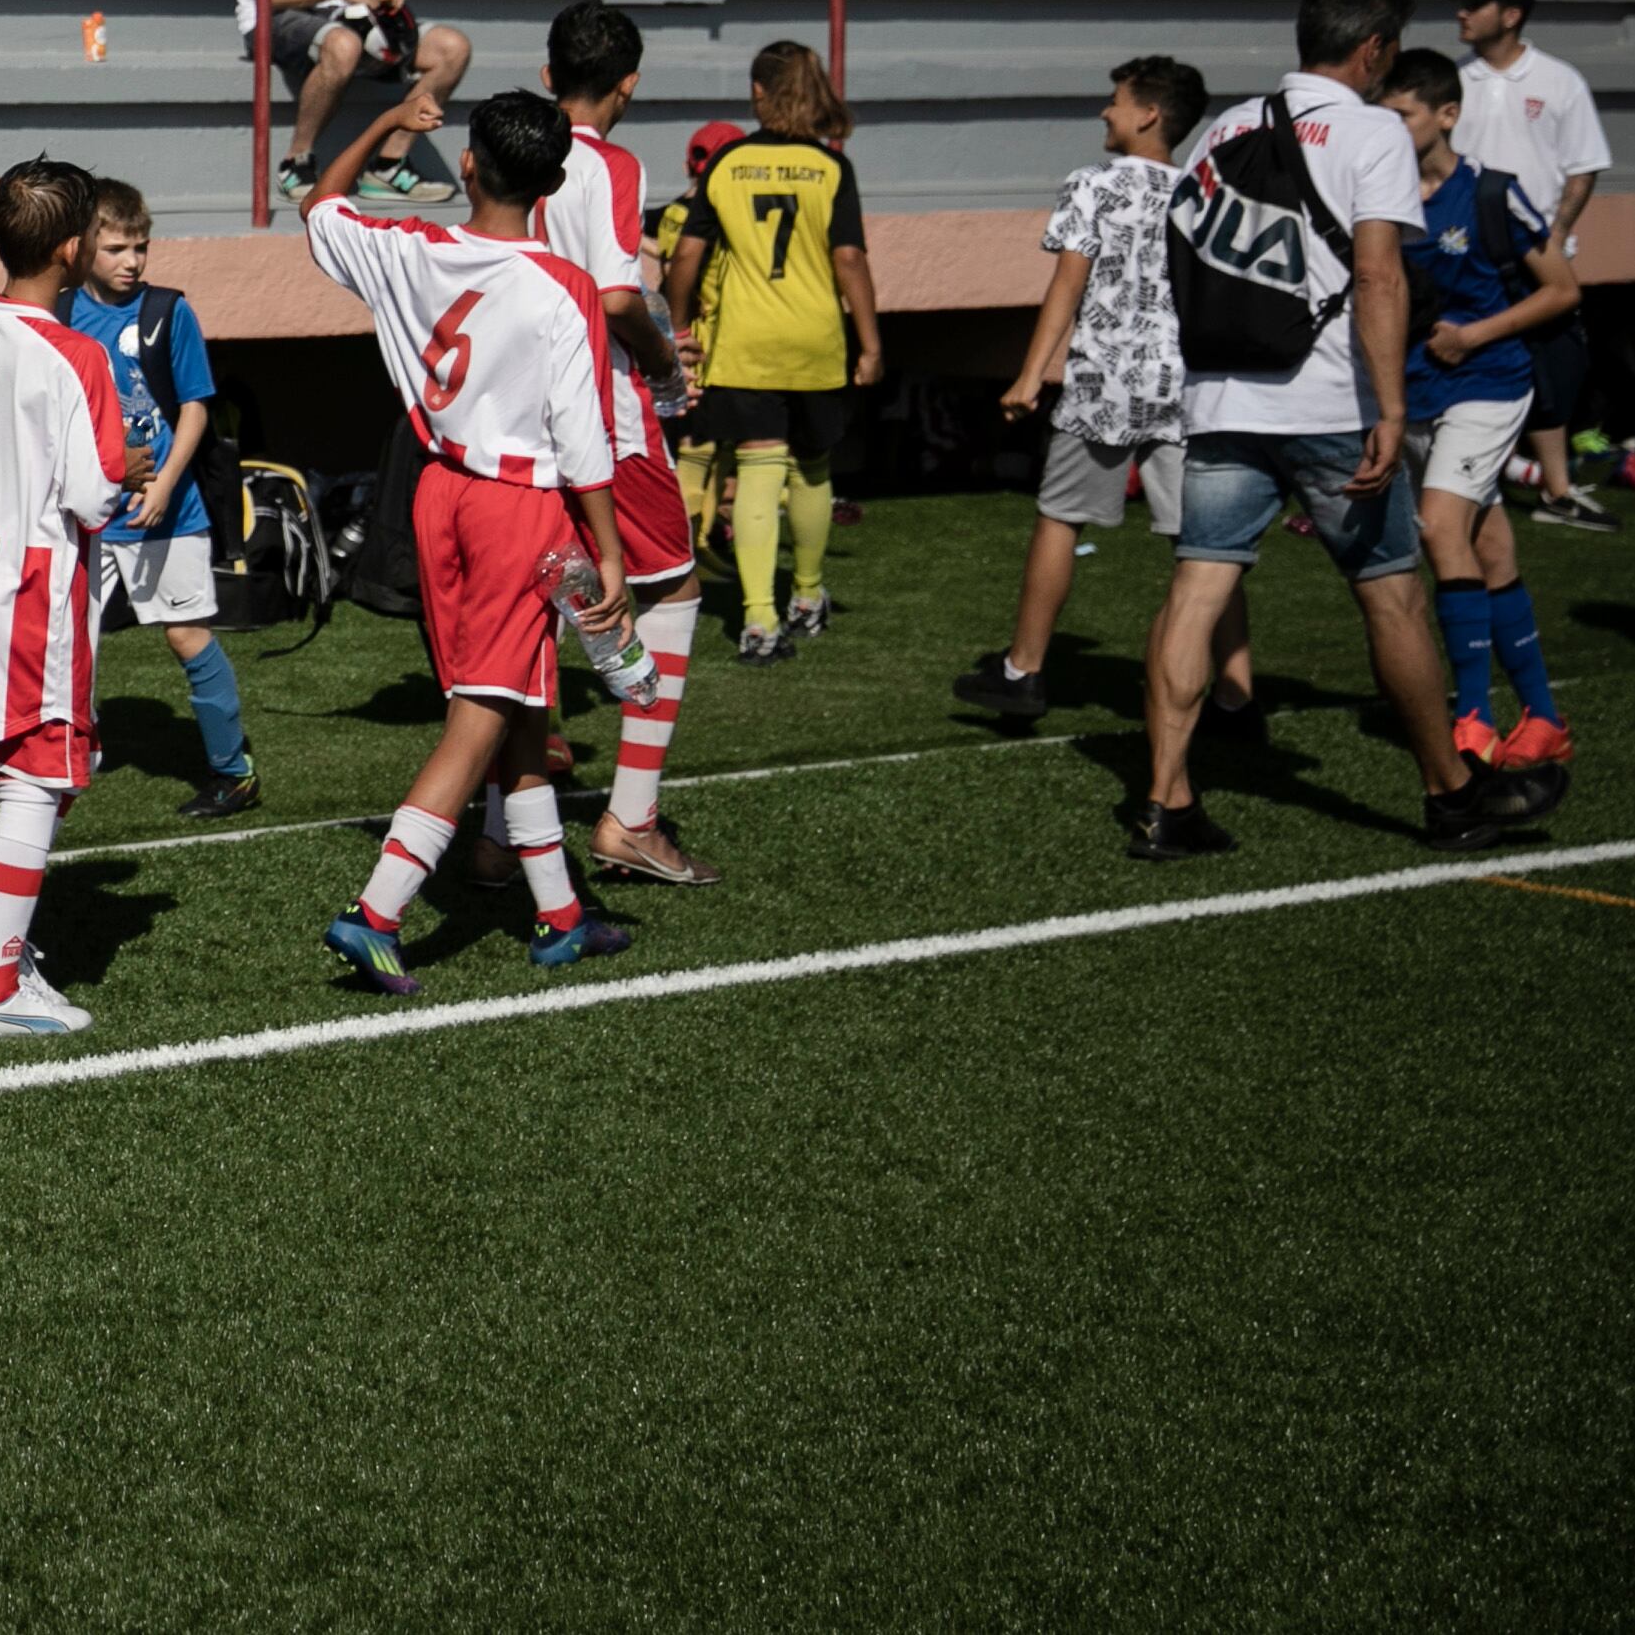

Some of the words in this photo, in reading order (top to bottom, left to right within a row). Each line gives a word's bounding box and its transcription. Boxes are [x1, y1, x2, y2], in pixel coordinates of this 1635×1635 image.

[730, 165, 770, 181] YOUNG
[777, 166, 825, 184] TALENT
[753, 193, 799, 280] 7
[421, 290, 484, 412] 6
